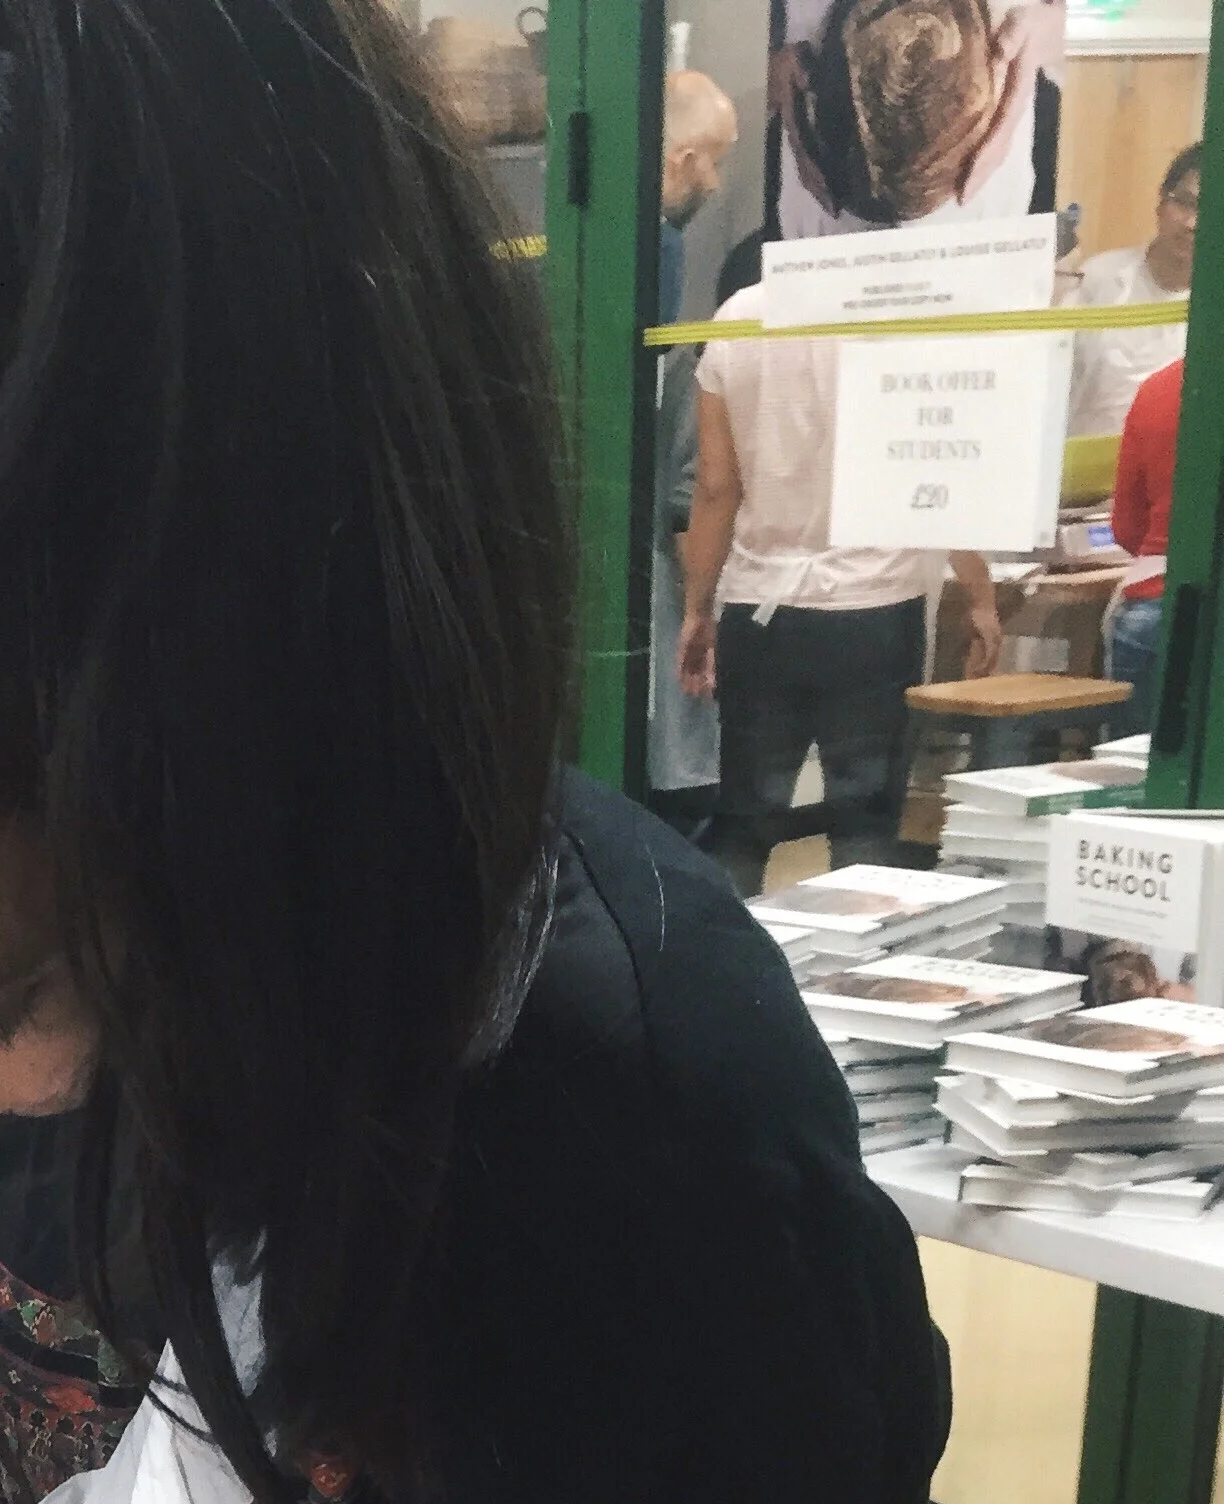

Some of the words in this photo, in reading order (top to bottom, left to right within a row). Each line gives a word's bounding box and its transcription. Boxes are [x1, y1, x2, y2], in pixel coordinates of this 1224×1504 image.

[880, 372, 934, 393] BOOK
[937, 369, 996, 391] OFFER
[917, 406, 954, 426] FOR
[886, 438, 982, 460] STUDENTS
[1077, 839, 1174, 874] BAKING
[1075, 865, 1172, 902] SCHOOL
